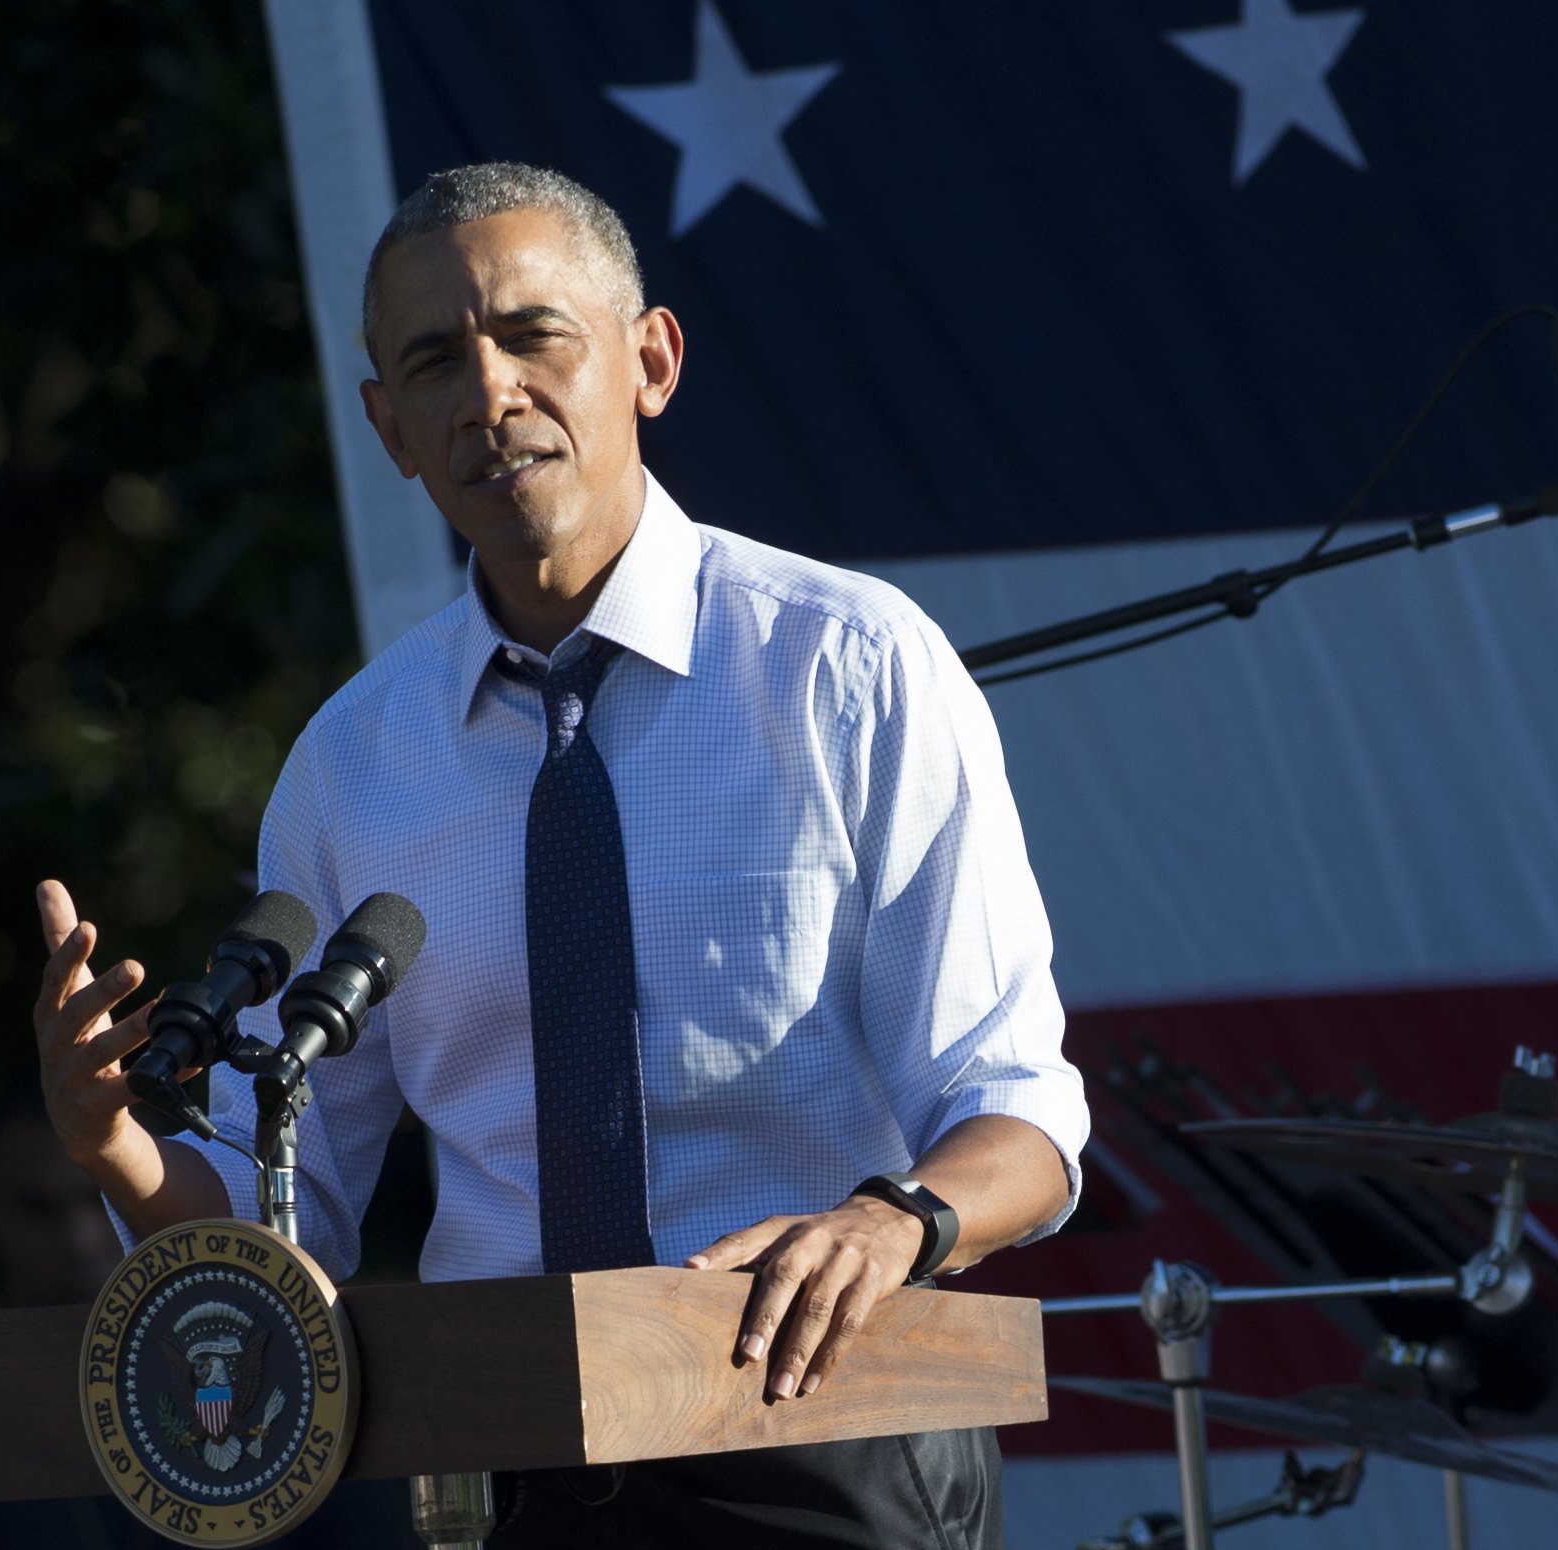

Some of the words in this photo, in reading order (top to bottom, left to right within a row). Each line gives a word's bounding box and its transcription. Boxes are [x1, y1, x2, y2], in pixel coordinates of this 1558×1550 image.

[206, 1234, 230, 1254] OF
[235, 1238, 270, 1269] THE
[89, 1231, 198, 1387] PRESIDENT
[278, 1263, 340, 1394] UNITED
[95, 1397, 119, 1442] THE
[108, 1447, 131, 1475] OF
[249, 1425, 334, 1530] STATES
[132, 1470, 201, 1534] SEAL
